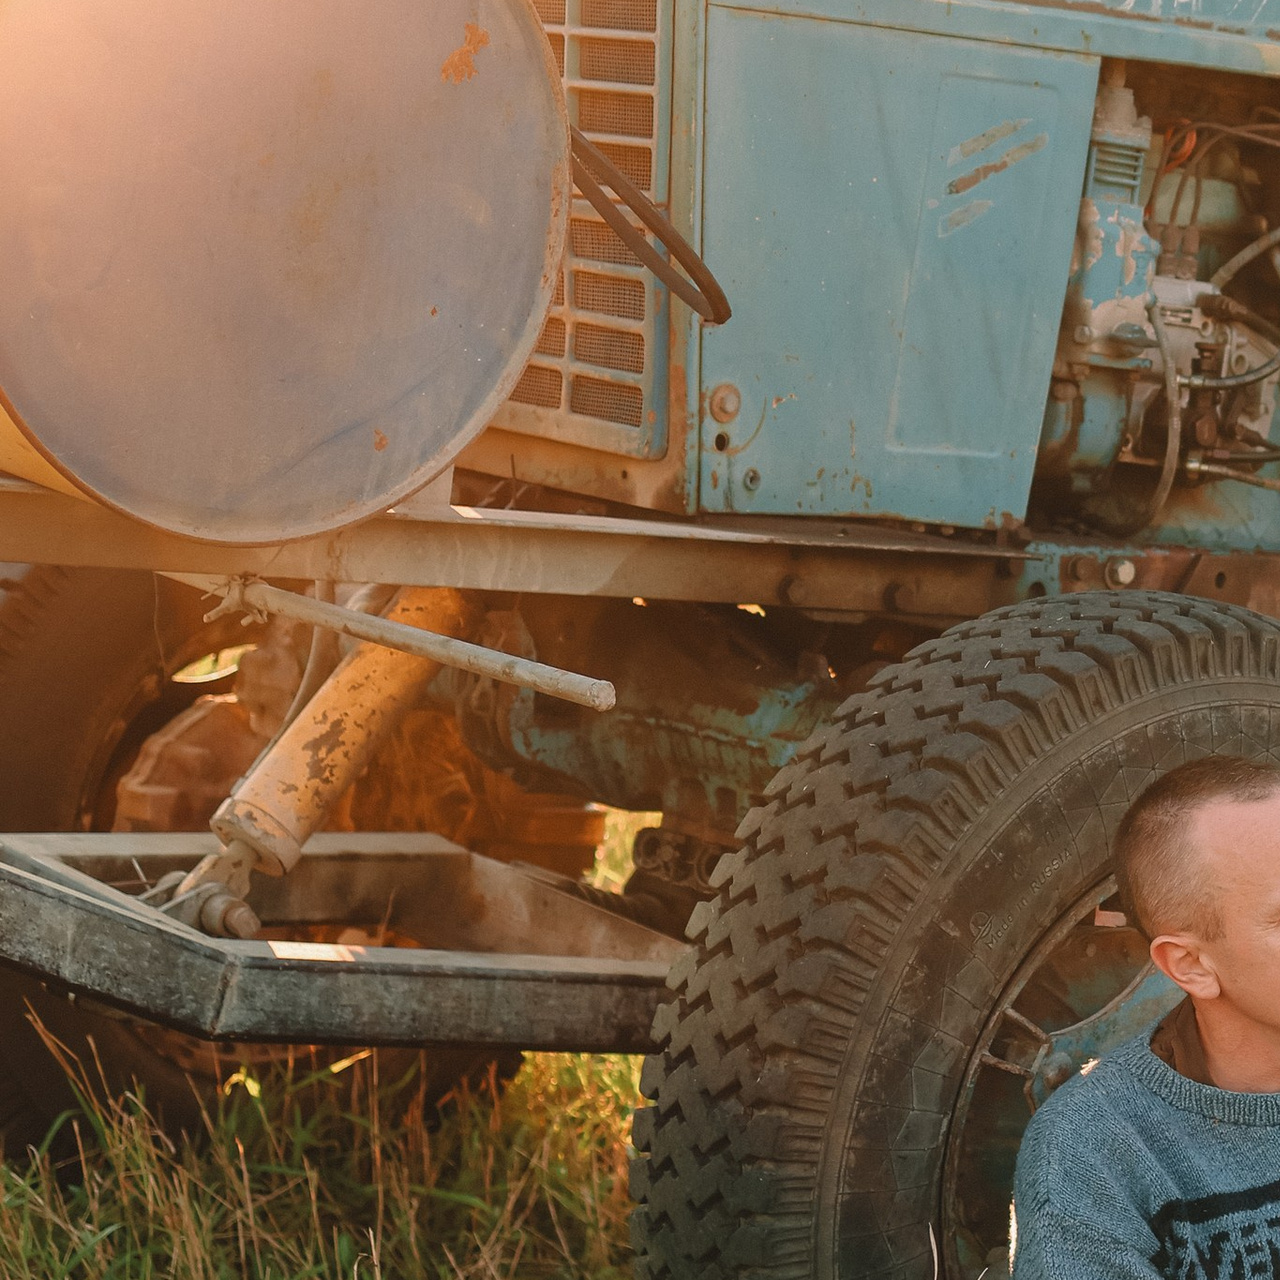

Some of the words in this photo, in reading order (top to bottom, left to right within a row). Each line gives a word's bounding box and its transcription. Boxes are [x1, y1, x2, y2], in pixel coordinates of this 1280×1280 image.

[984, 913, 1014, 950] Made
[1016, 897, 1028, 912] in
[1030, 848, 1072, 895] RUSSIA
